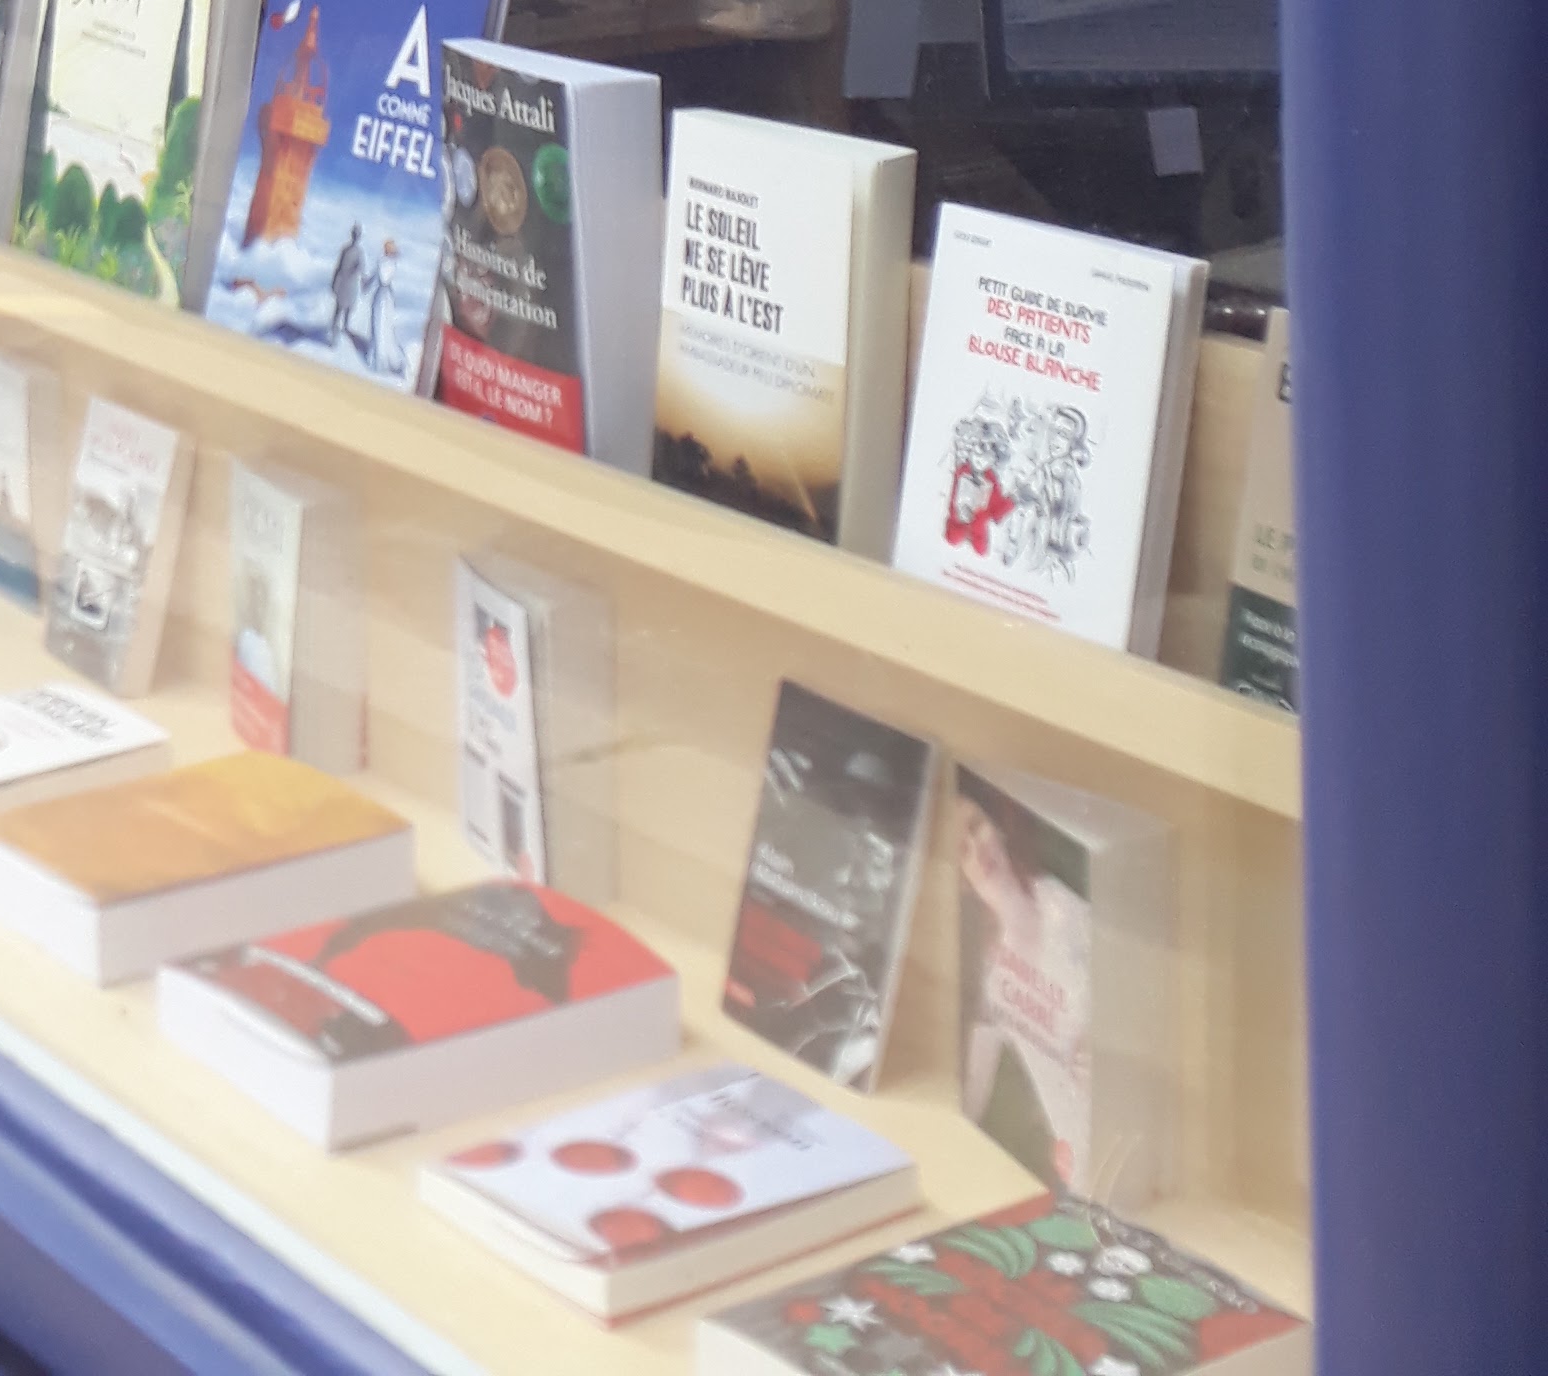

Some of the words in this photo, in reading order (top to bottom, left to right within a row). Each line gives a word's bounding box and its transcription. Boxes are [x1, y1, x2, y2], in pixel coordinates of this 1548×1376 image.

[384, 2, 431, 98] A
[376, 92, 432, 128] COMME
[497, 86, 556, 134] Attali
[351, 112, 437, 180] EIFFEL
[686, 199, 704, 233] LE
[706, 206, 761, 252] SOLEIL
[523, 254, 548, 292] de
[684, 236, 702, 271] NE
[706, 244, 727, 280] SE
[681, 273, 719, 316] PLUS
[738, 293, 784, 335] L'EST
[978, 275, 1009, 299] PETIT
[987, 296, 1013, 320] DES
[1016, 305, 1092, 345] PATIENTS
[1003, 326, 1033, 348] FACE
[968, 334, 1021, 368] BLOUSE
[1025, 351, 1101, 393] BLANCHE
